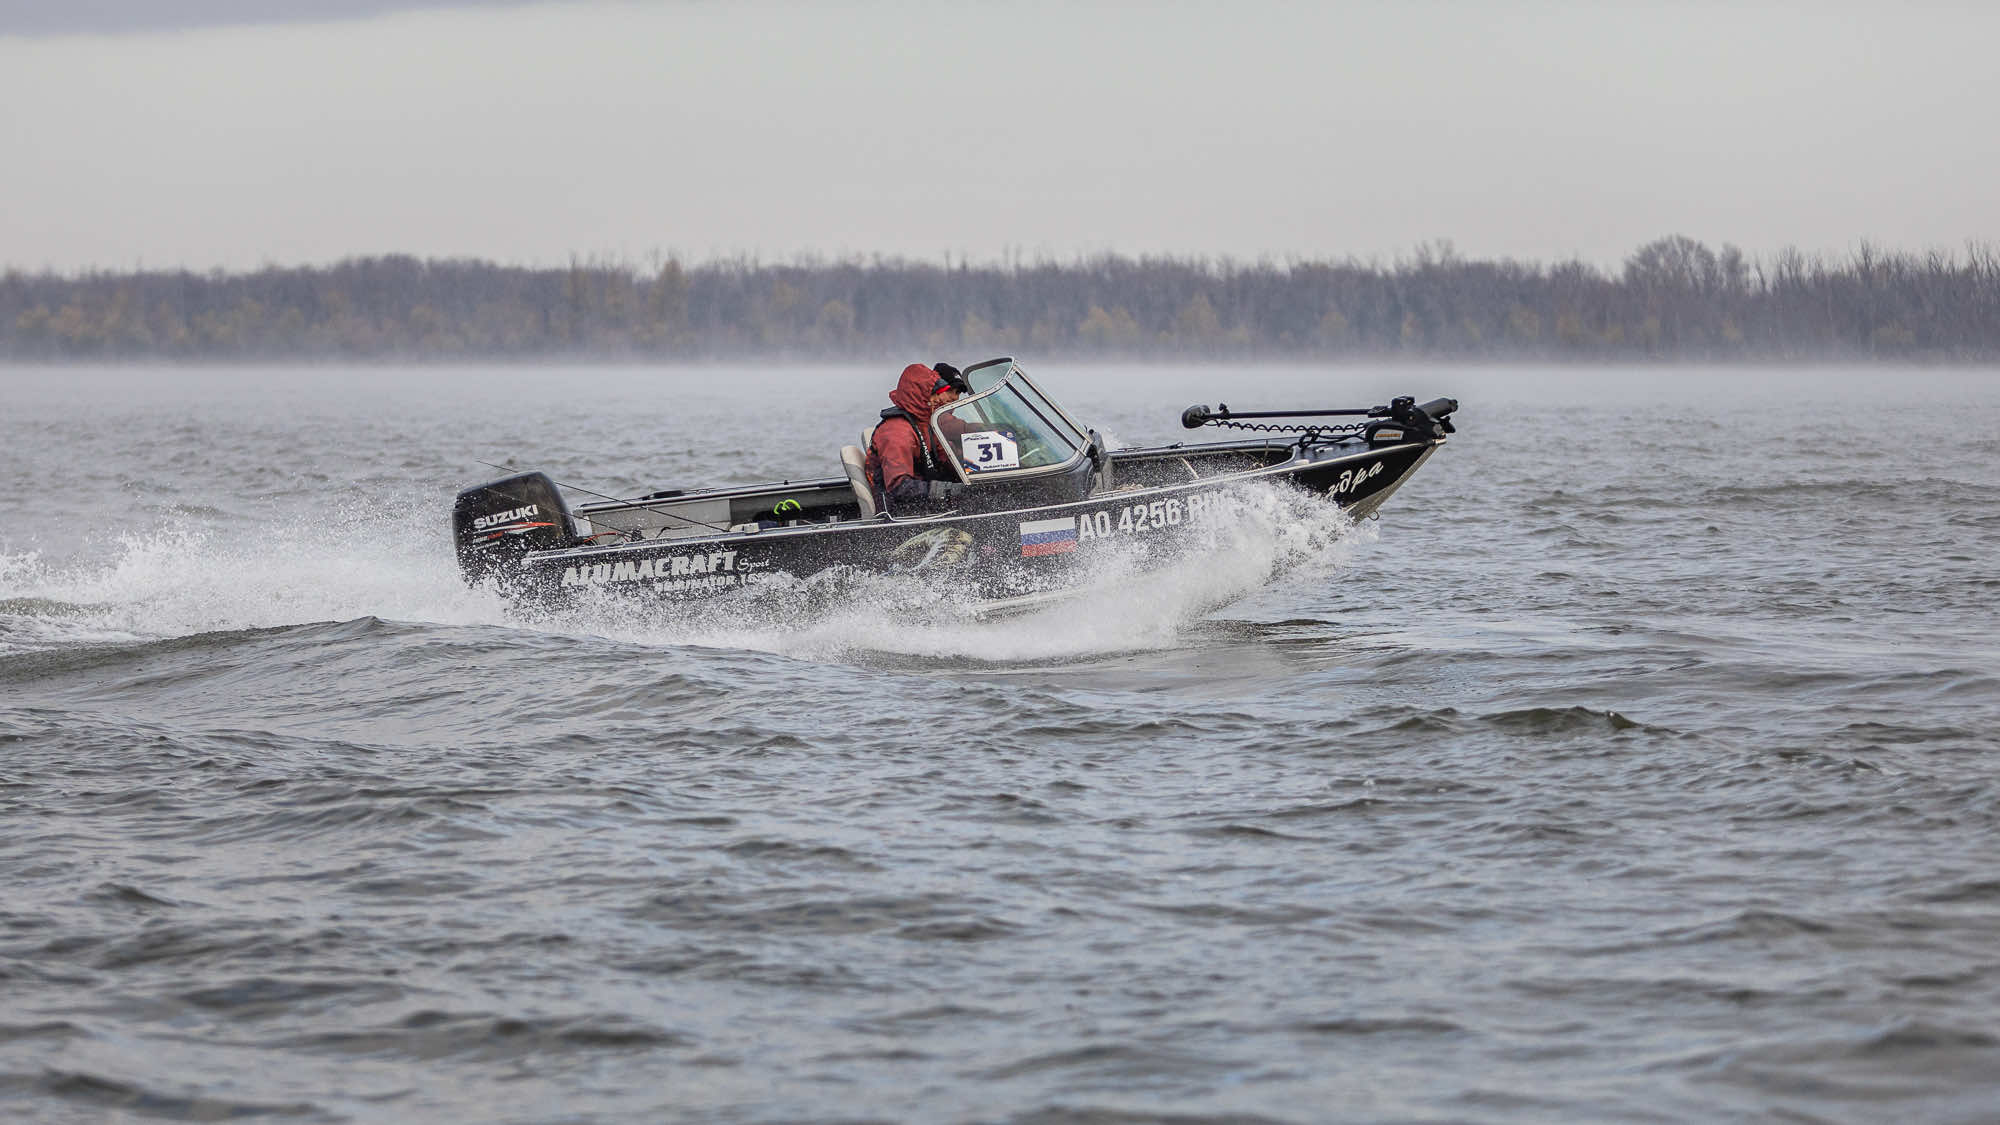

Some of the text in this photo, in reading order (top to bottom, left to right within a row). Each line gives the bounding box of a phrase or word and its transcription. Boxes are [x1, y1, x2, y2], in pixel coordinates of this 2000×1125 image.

[977, 442, 1004, 462] 31
[473, 504, 539, 529] SUZUKI
[1117, 499, 1183, 536] 4256
[560, 551, 738, 588] ALUMACRAFT
[737, 557, 770, 573] Sport
